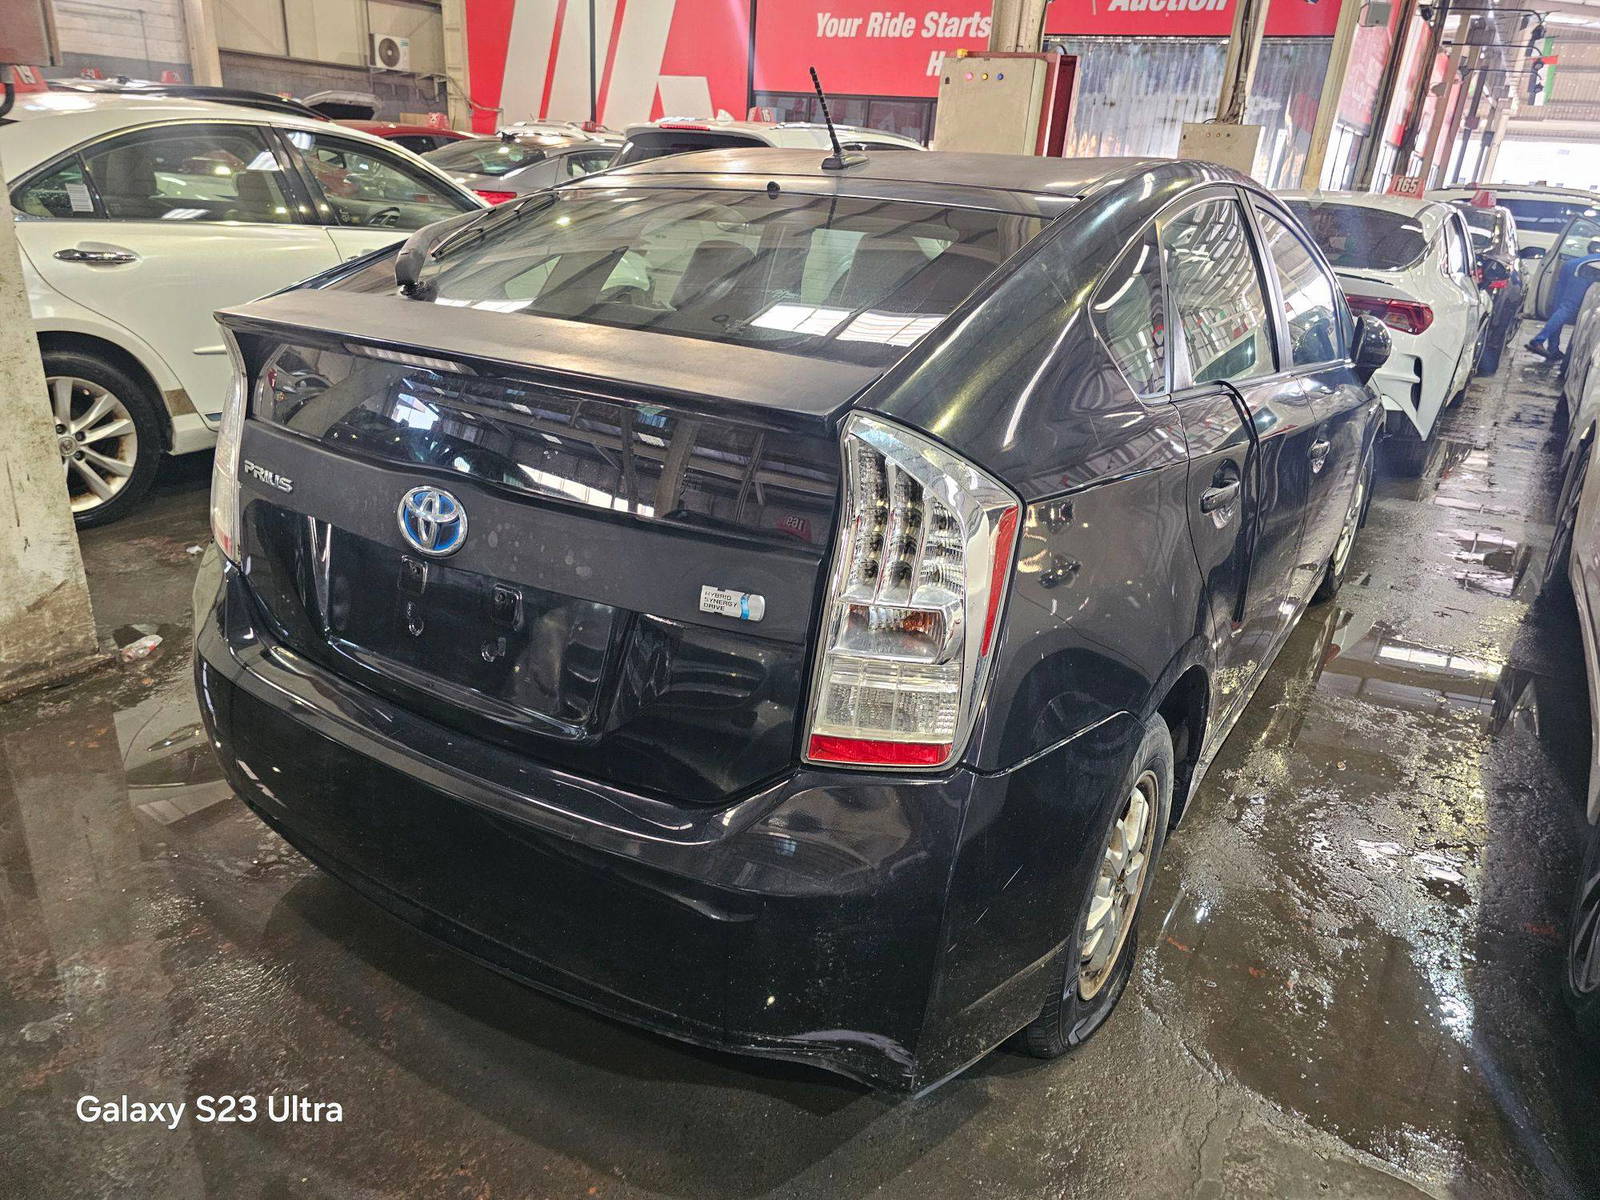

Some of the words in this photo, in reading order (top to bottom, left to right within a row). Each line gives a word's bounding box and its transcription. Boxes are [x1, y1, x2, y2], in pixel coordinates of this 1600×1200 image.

[816, 12, 863, 38] Your
[866, 12, 916, 38] Ride
[921, 11, 992, 38] Starts
[1396, 177, 1419, 193] 165
[243, 459, 293, 493] PRIUS
[704, 591, 732, 601] HYBRID
[704, 596, 738, 608] SYNERGY
[703, 602, 725, 611] DRIVE
